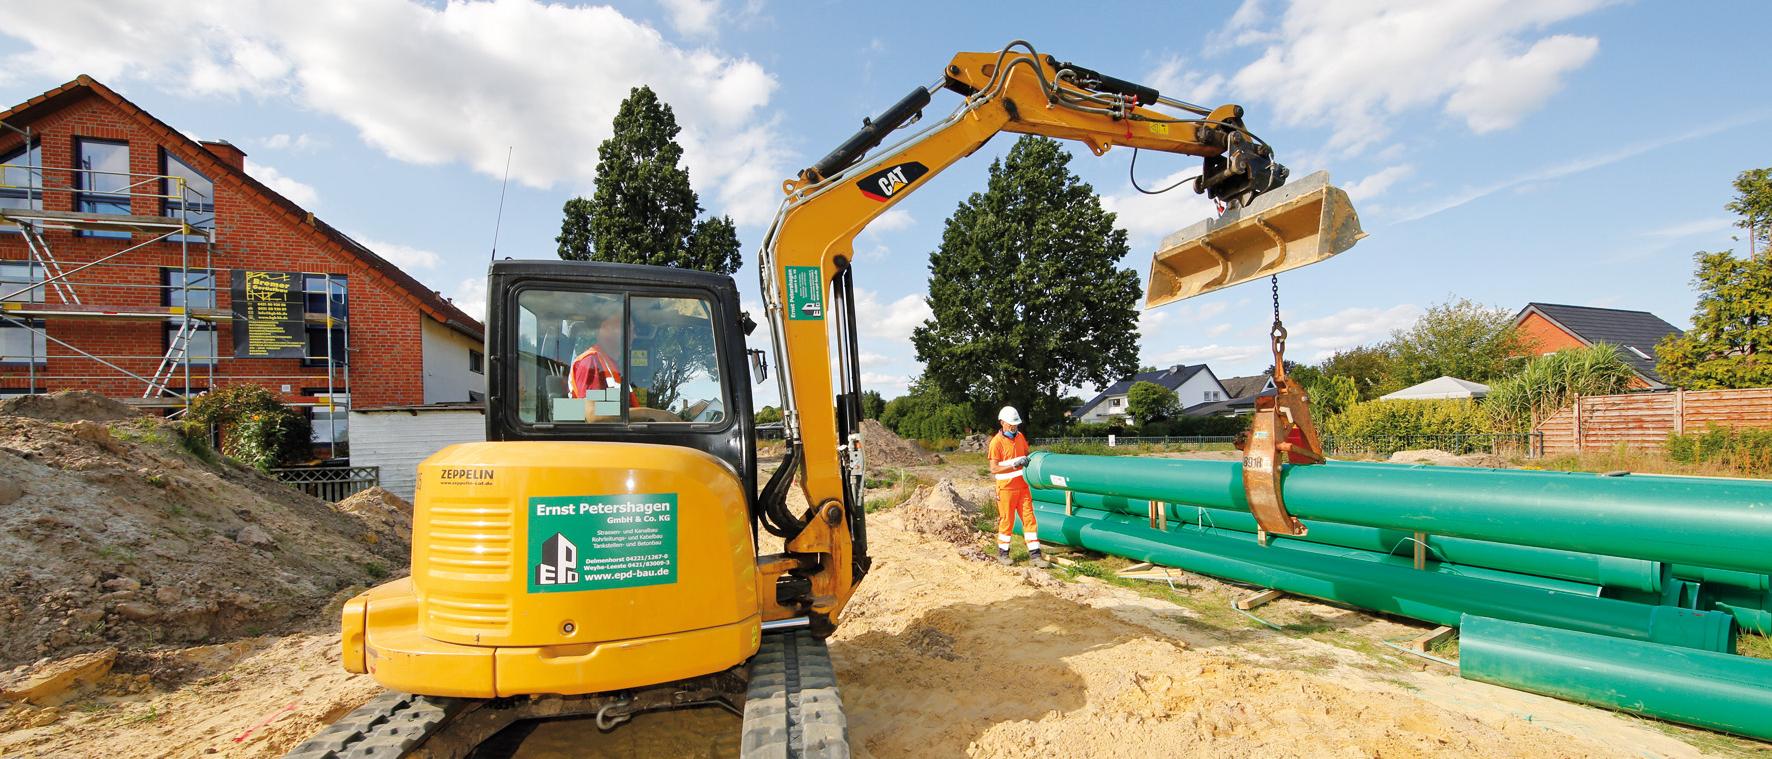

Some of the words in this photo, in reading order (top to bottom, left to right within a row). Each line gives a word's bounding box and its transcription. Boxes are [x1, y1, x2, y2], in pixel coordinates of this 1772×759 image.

[878, 166, 908, 196] CAT
[441, 469, 494, 480] ZEPPELIN
[536, 504, 576, 516] Ernst
[580, 502, 670, 514] Petershagen
[625, 554, 668, 562] 04221/1267-0
[628, 560, 670, 568] 0421/83009-3
[584, 568, 670, 581] www.epd-bau.de
